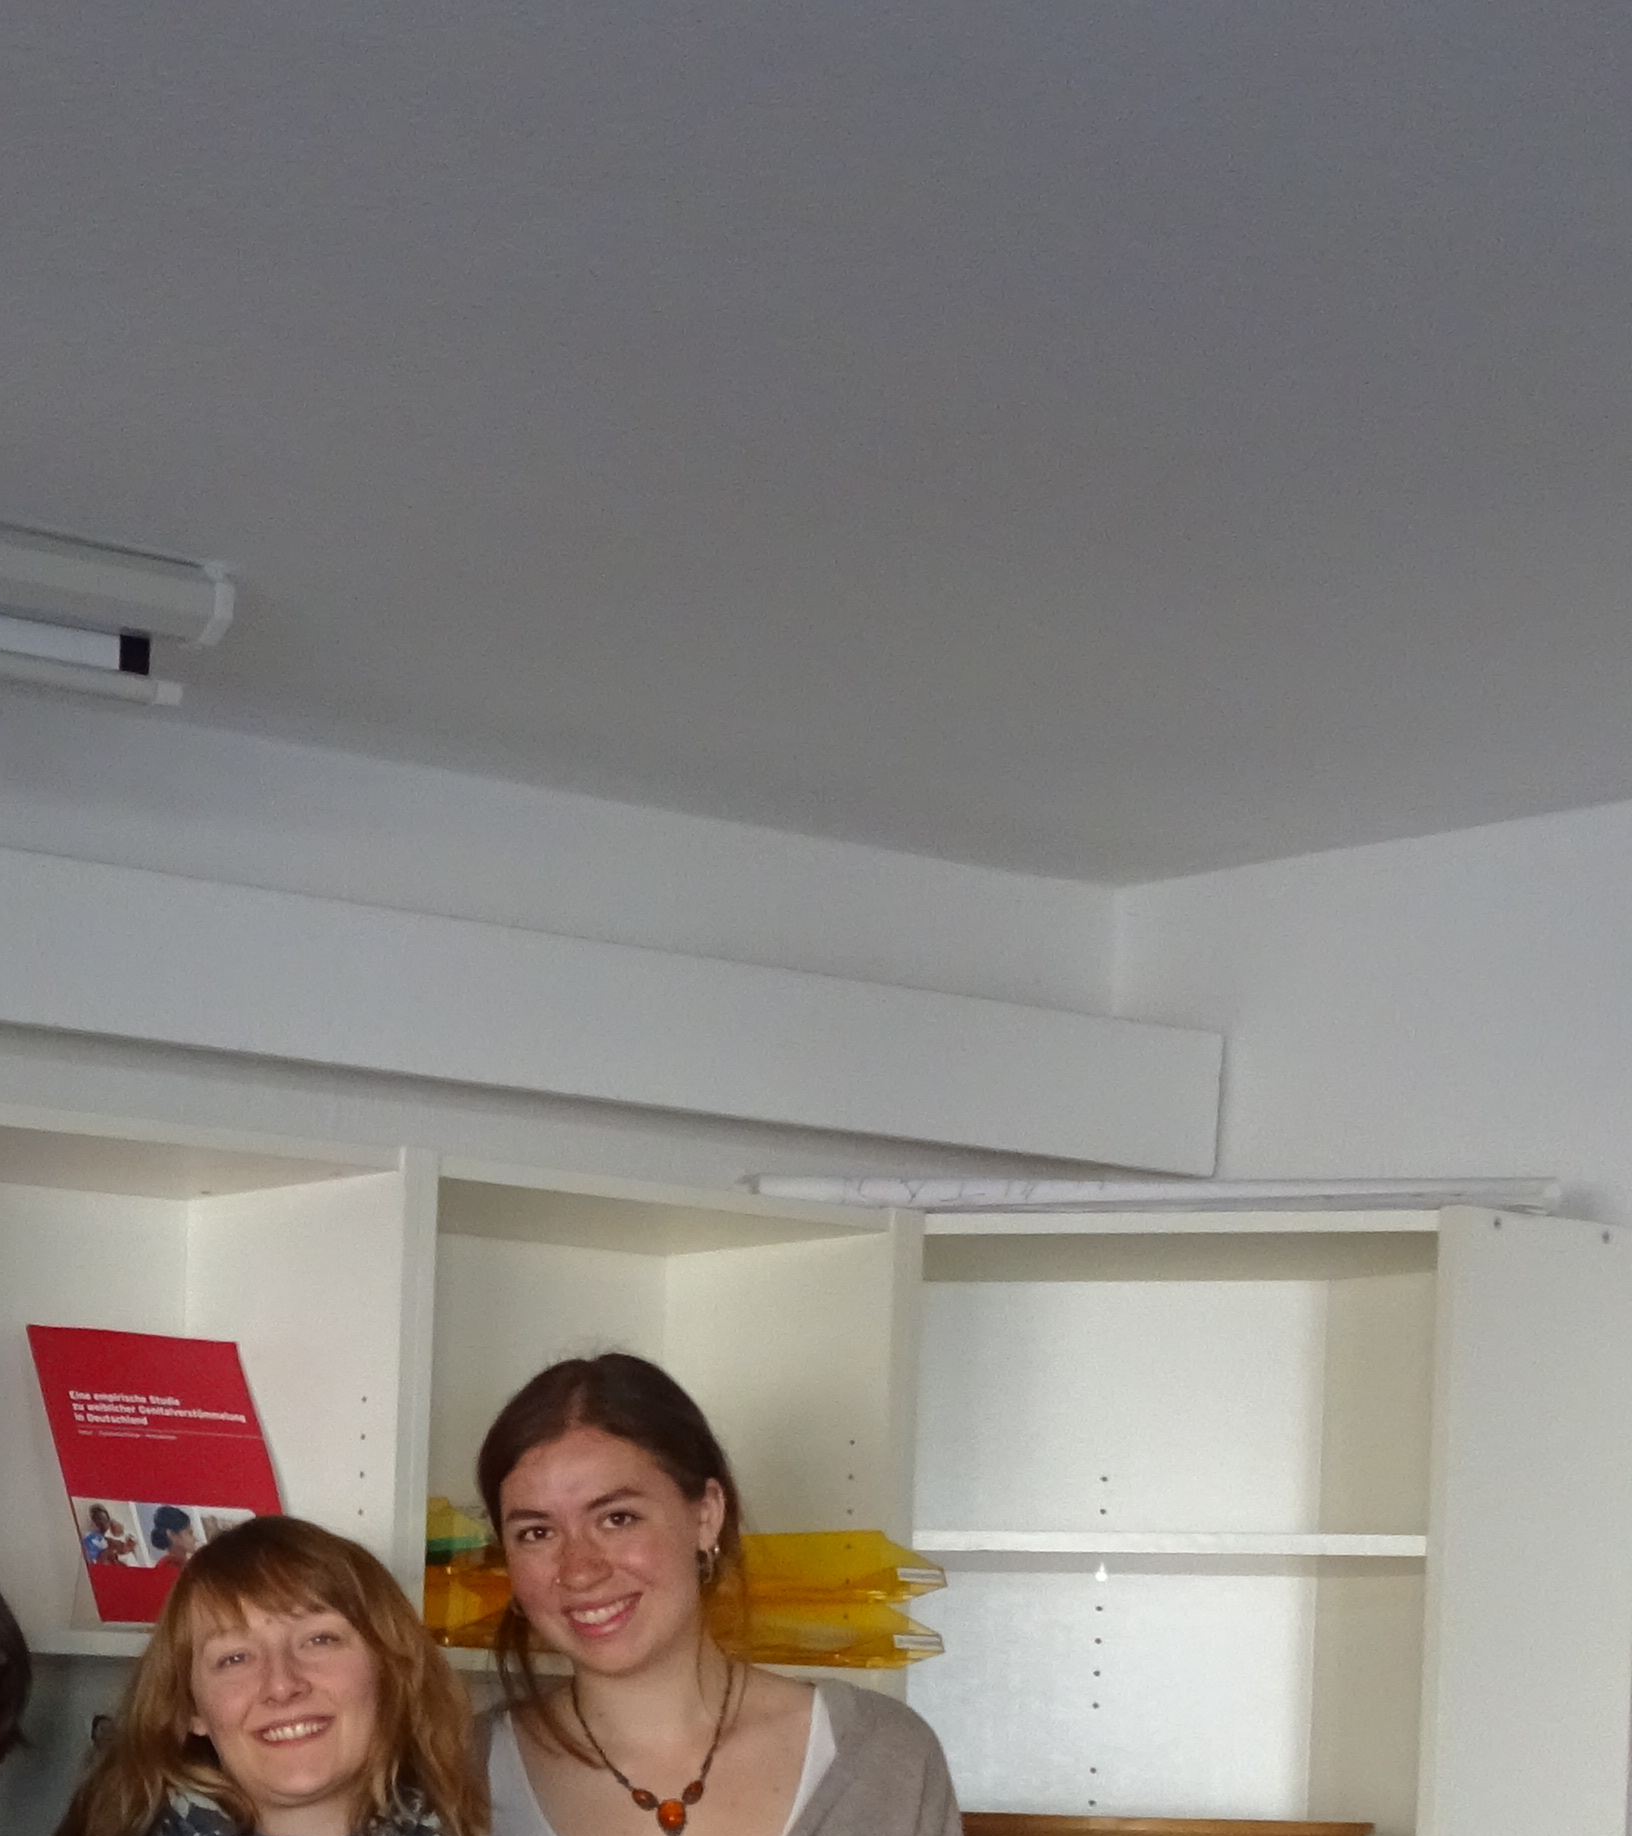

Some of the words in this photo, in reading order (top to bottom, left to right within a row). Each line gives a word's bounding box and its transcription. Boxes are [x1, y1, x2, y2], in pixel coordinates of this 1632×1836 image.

[68, 1390, 92, 1401] Eine
[92, 1392, 148, 1404] empirische
[148, 1395, 181, 1406] Studie
[73, 1412, 85, 1422] in
[86, 1414, 149, 1426] Deutschland
[86, 1403, 137, 1414] weiblicher
[138, 1405, 247, 1423] Genitalverstümmelung
